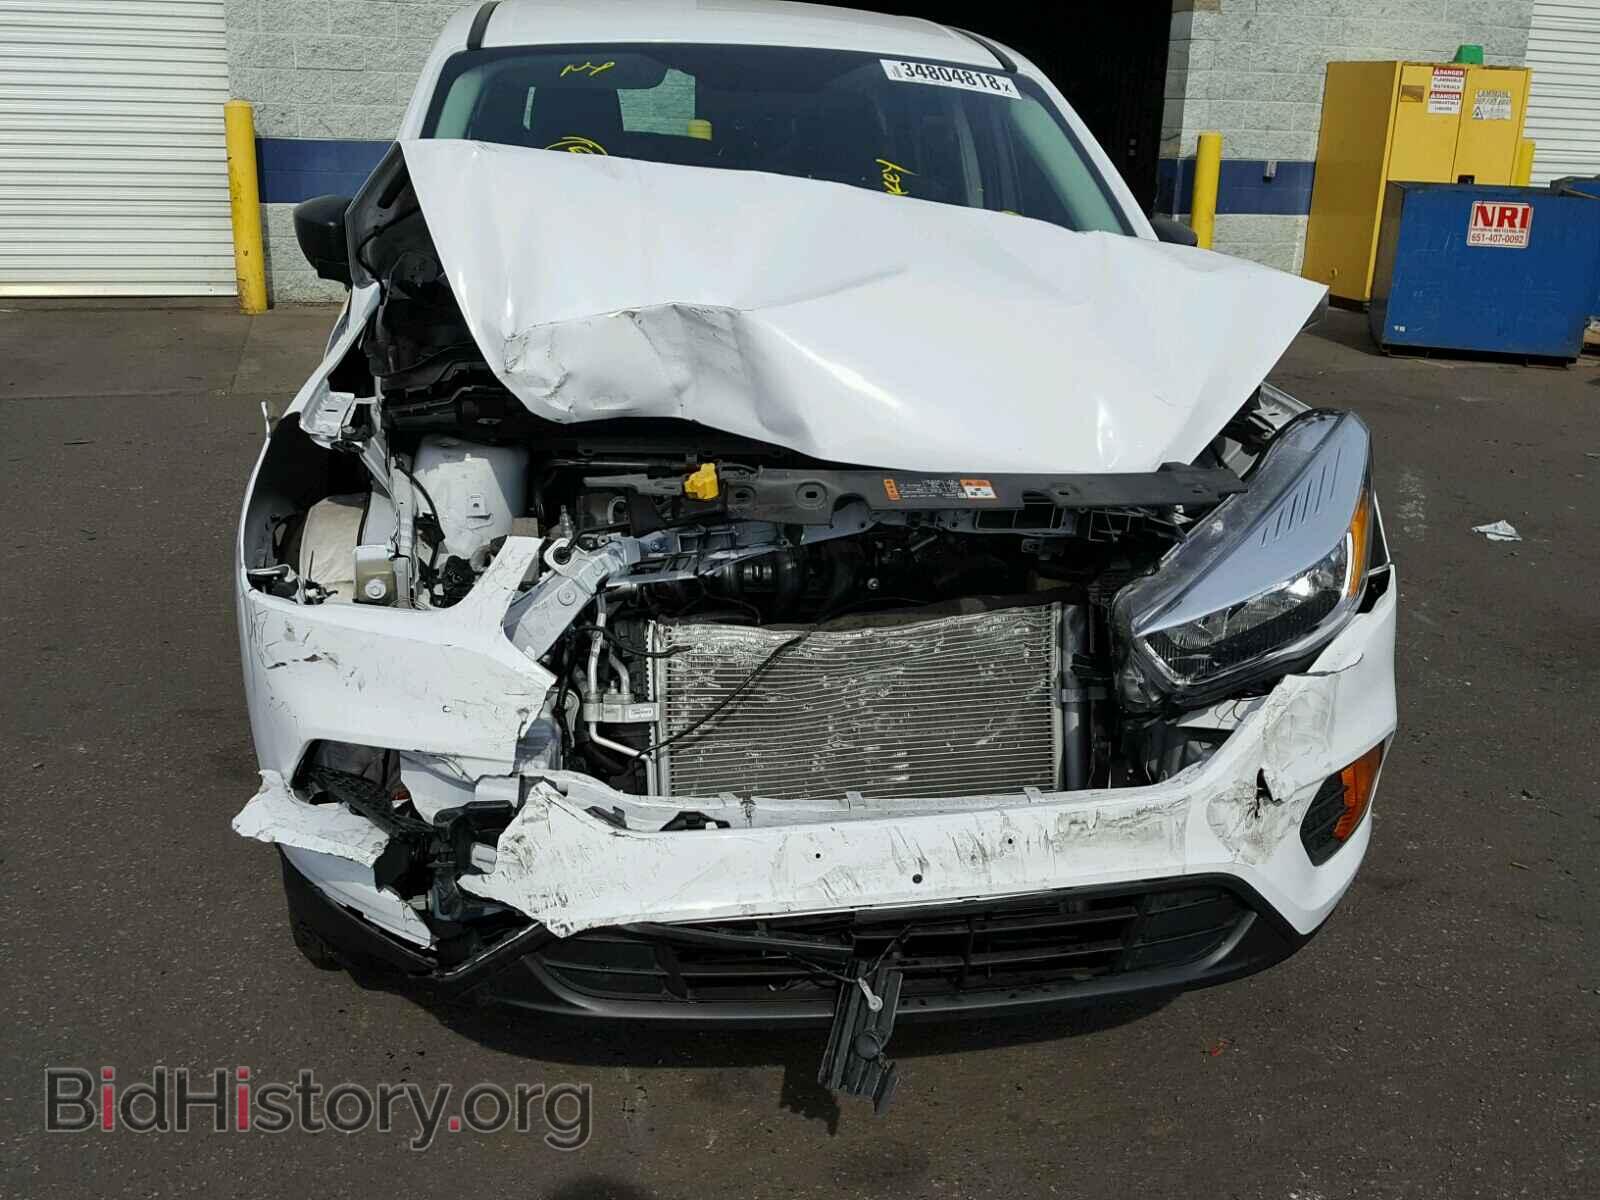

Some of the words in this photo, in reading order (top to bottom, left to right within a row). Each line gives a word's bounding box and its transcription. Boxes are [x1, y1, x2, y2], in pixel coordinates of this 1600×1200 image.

[900, 62, 1001, 90] 34804818
[1474, 205, 1530, 229] NRI
[1471, 233, 1524, 244] 651-407-0092
